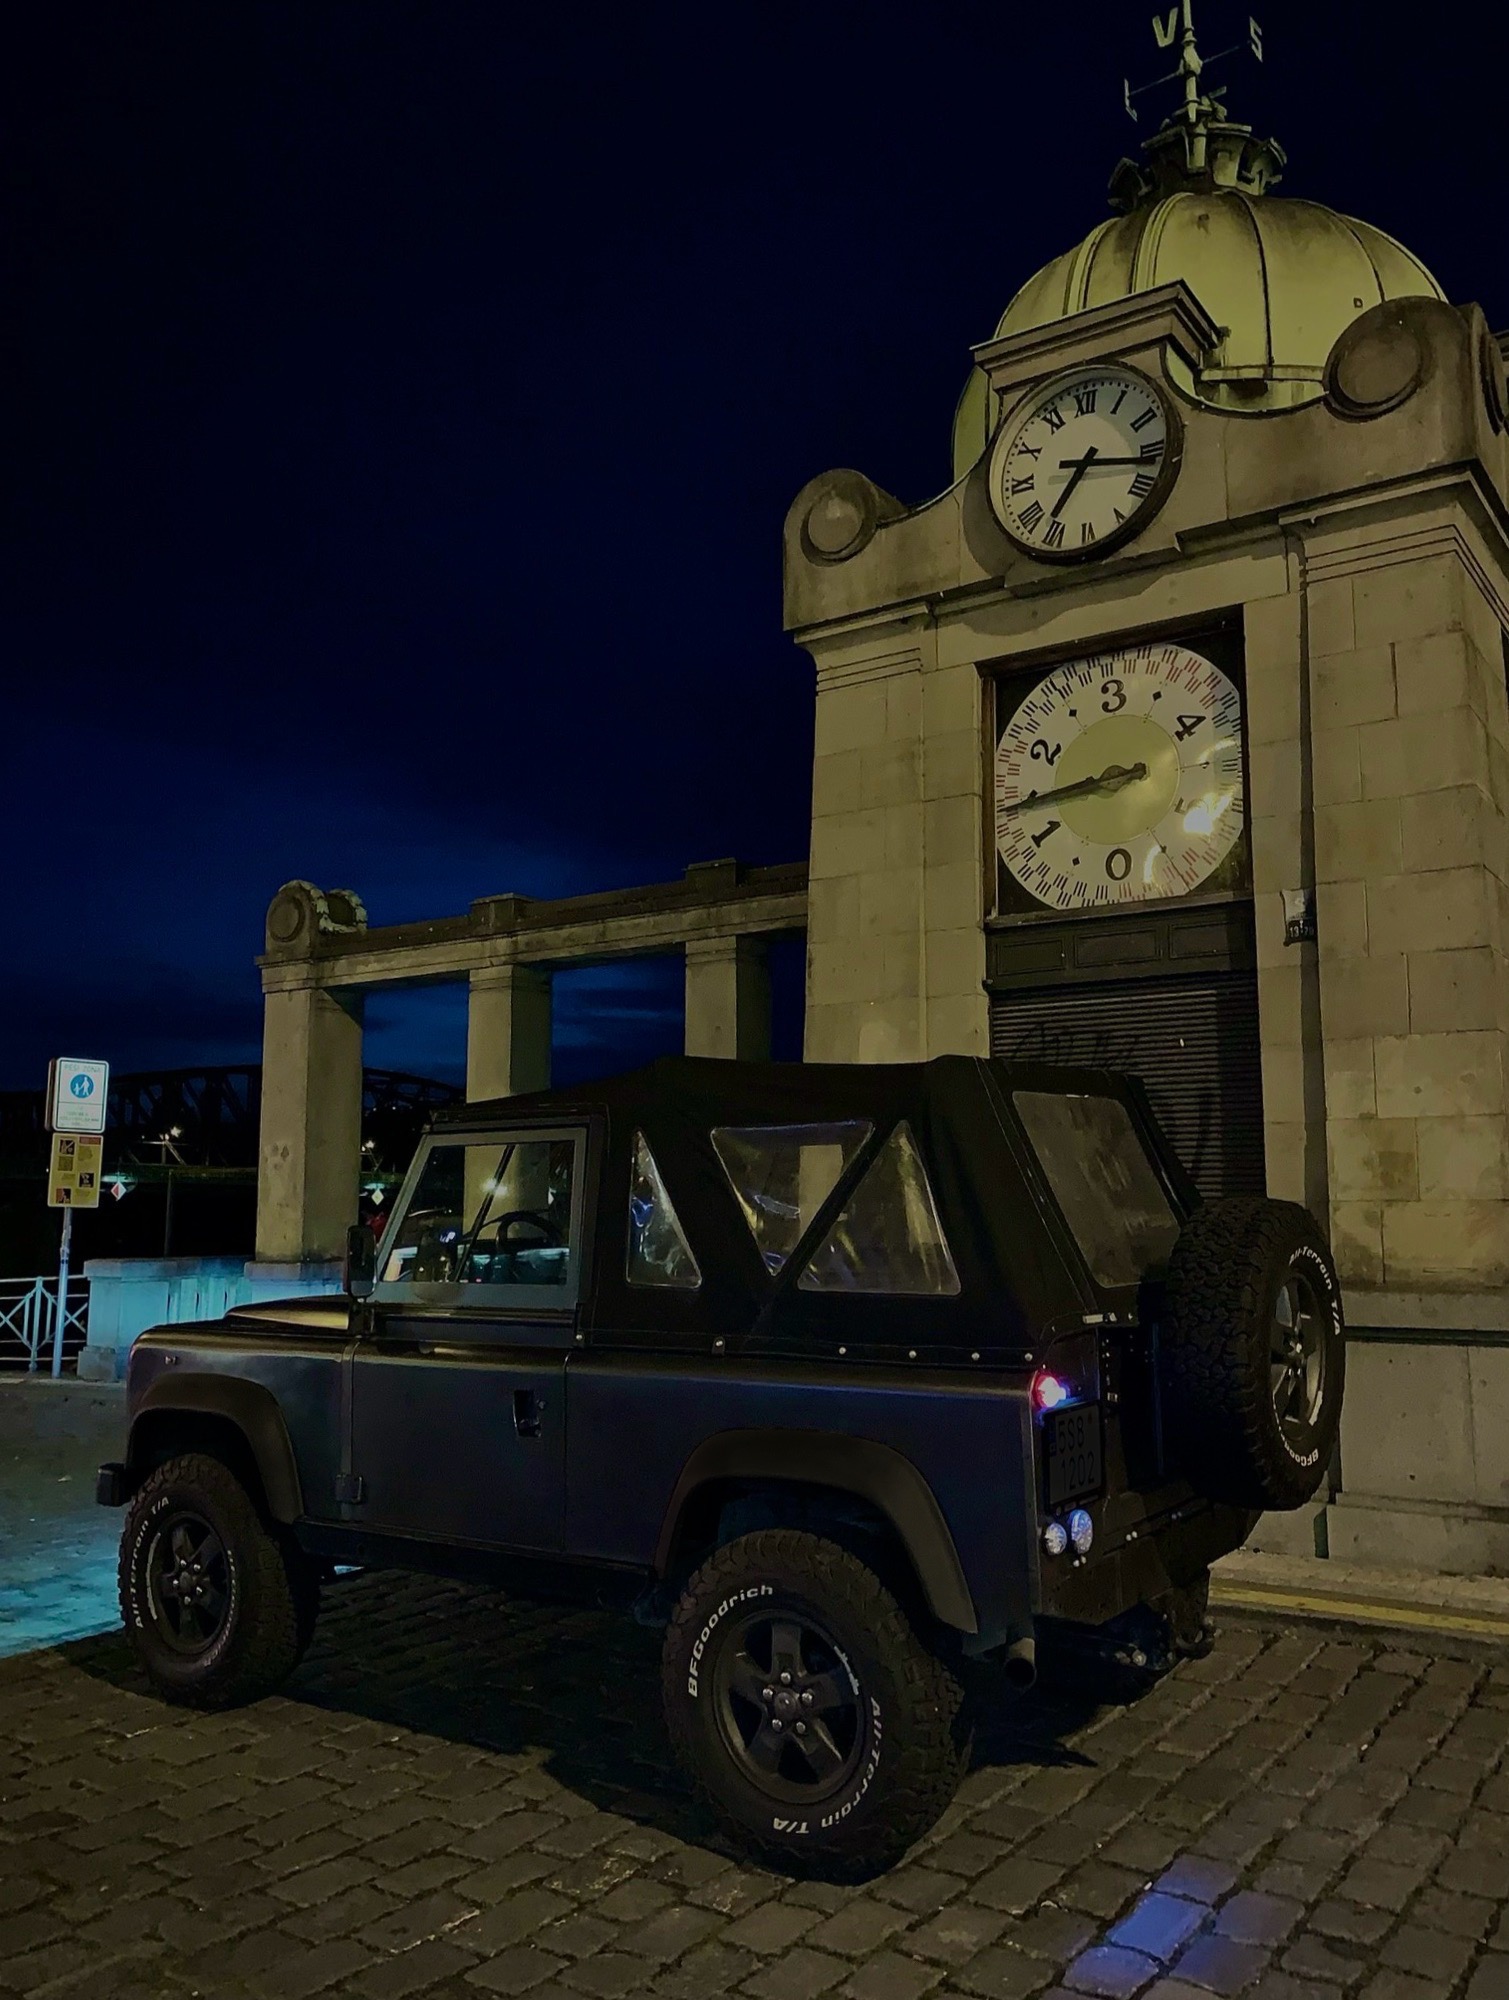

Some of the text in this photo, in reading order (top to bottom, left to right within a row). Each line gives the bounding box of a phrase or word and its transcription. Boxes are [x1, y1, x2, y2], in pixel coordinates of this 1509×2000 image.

[1073, 389, 1098, 418] XII
[1110, 390, 1127, 415] I
[1041, 406, 1066, 435] XI
[1017, 441, 1042, 461] X
[1101, 679, 1127, 713] 3
[1174, 714, 1206, 742] 4
[1030, 739, 1062, 766] 2
[1031, 820, 1061, 848] 1
[1105, 848, 1132, 881] 0
[1288, 1245, 1333, 1290] All-Terrain
[1061, 1451, 1095, 1492] 1202
[687, 1584, 774, 1698] BFGoodrich
[772, 1697, 882, 1834] All-Terrain T/A
